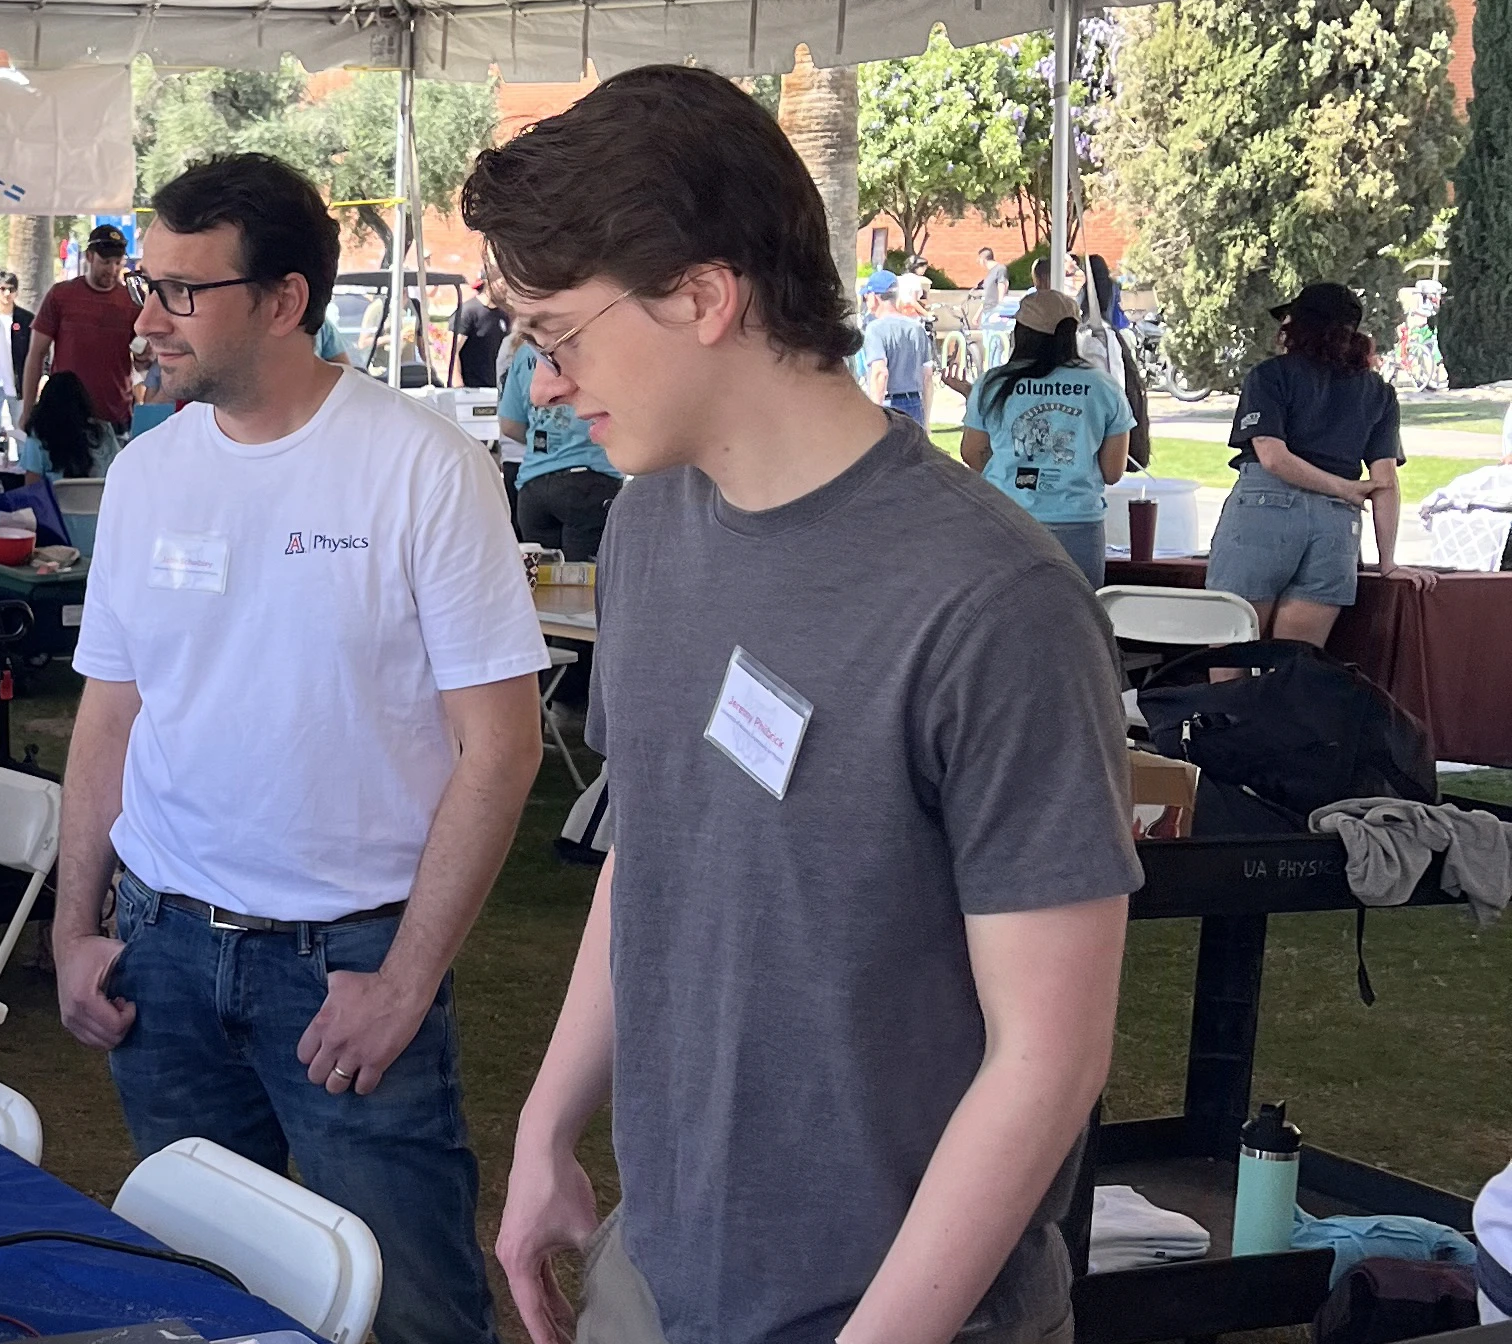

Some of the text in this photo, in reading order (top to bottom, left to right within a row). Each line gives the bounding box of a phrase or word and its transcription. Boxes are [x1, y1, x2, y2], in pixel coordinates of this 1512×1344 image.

[1015, 379, 1092, 396] olunteer
[313, 534, 369, 554] Physics
[1243, 860, 1267, 878] UA
